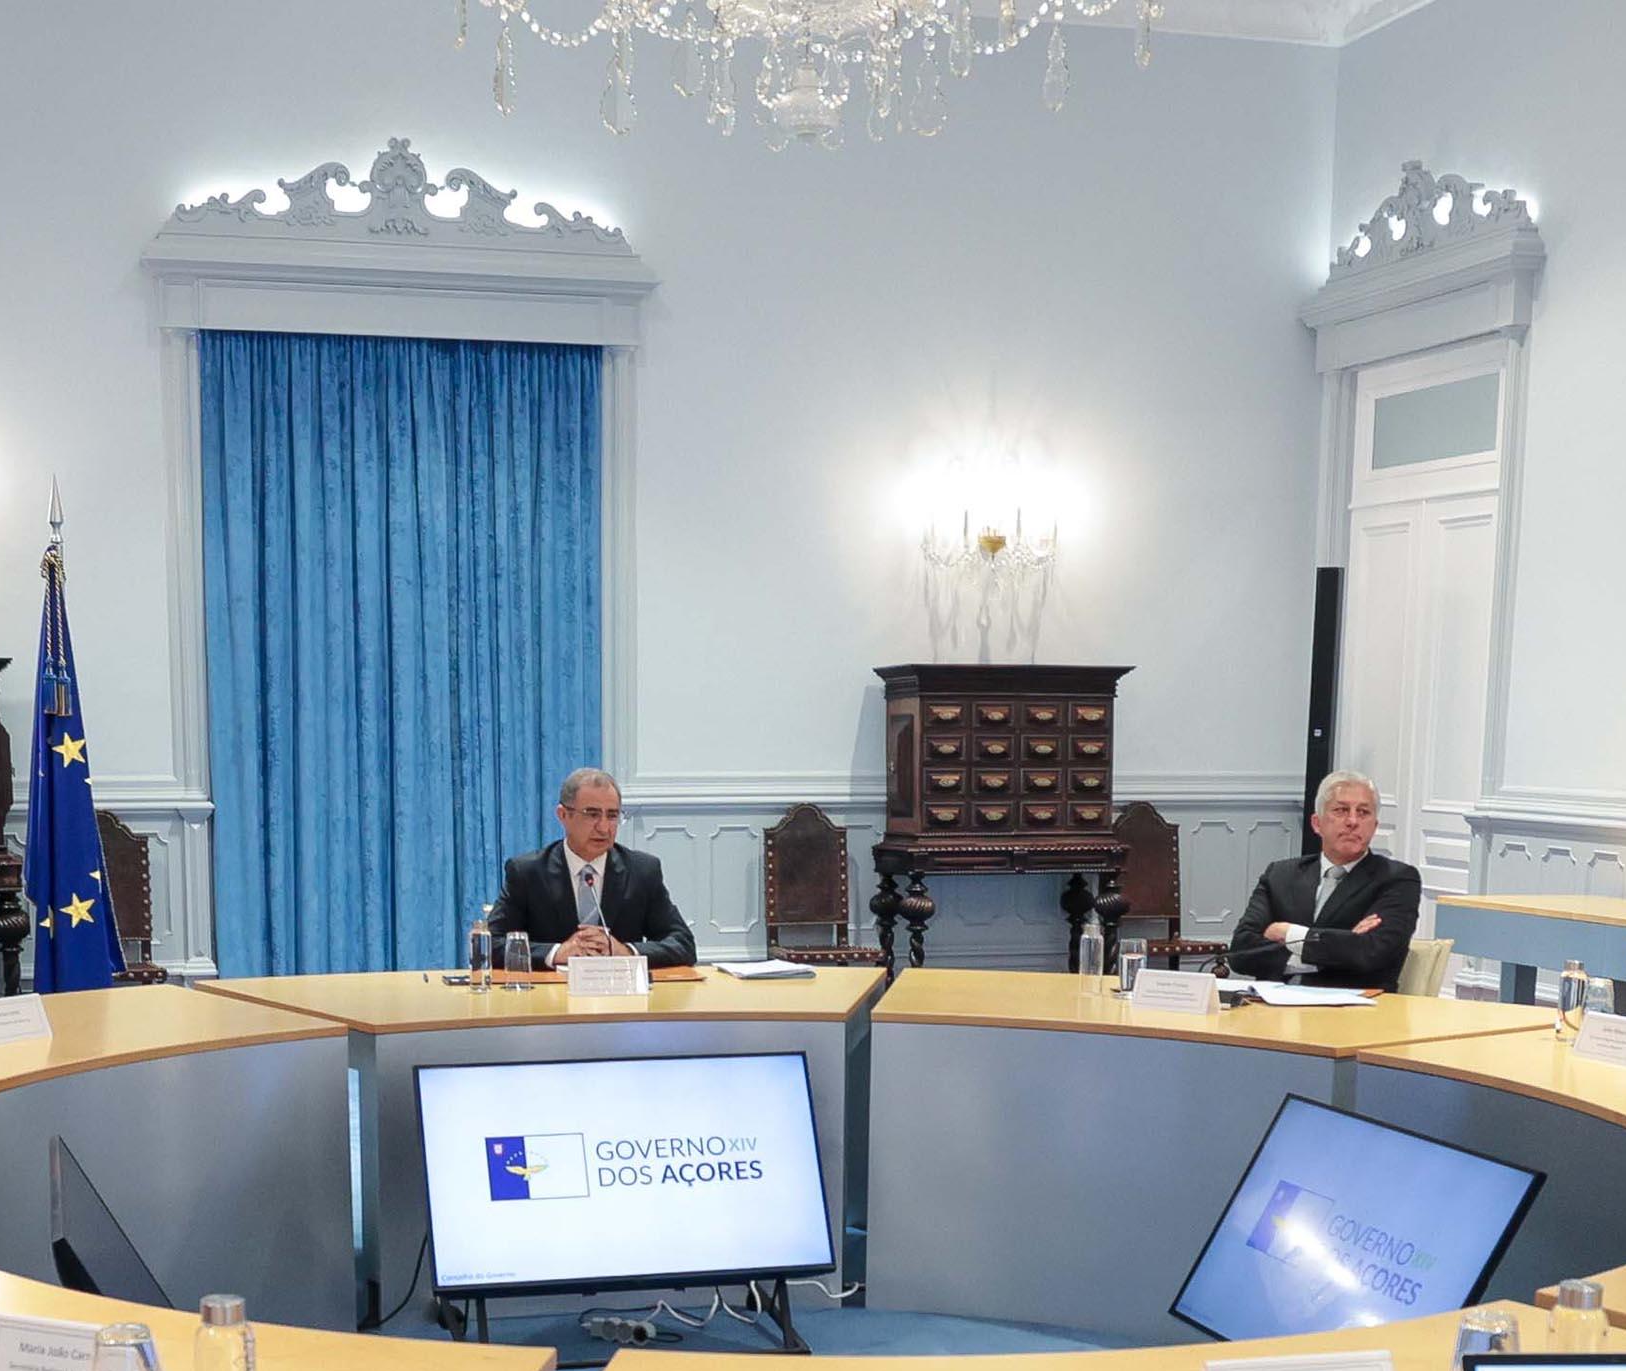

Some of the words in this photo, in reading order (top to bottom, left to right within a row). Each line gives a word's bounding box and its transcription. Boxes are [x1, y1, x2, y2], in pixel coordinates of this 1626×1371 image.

[595, 1136, 726, 1161] GOVERNO
[728, 1137, 757, 1152] XIV
[597, 1165, 653, 1187] DOS
[660, 1160, 764, 1187] AÇORES
[1328, 1215, 1415, 1266] GOVERNO
[19, 1343, 46, 1355] Maria
[48, 1346, 69, 1359] João
